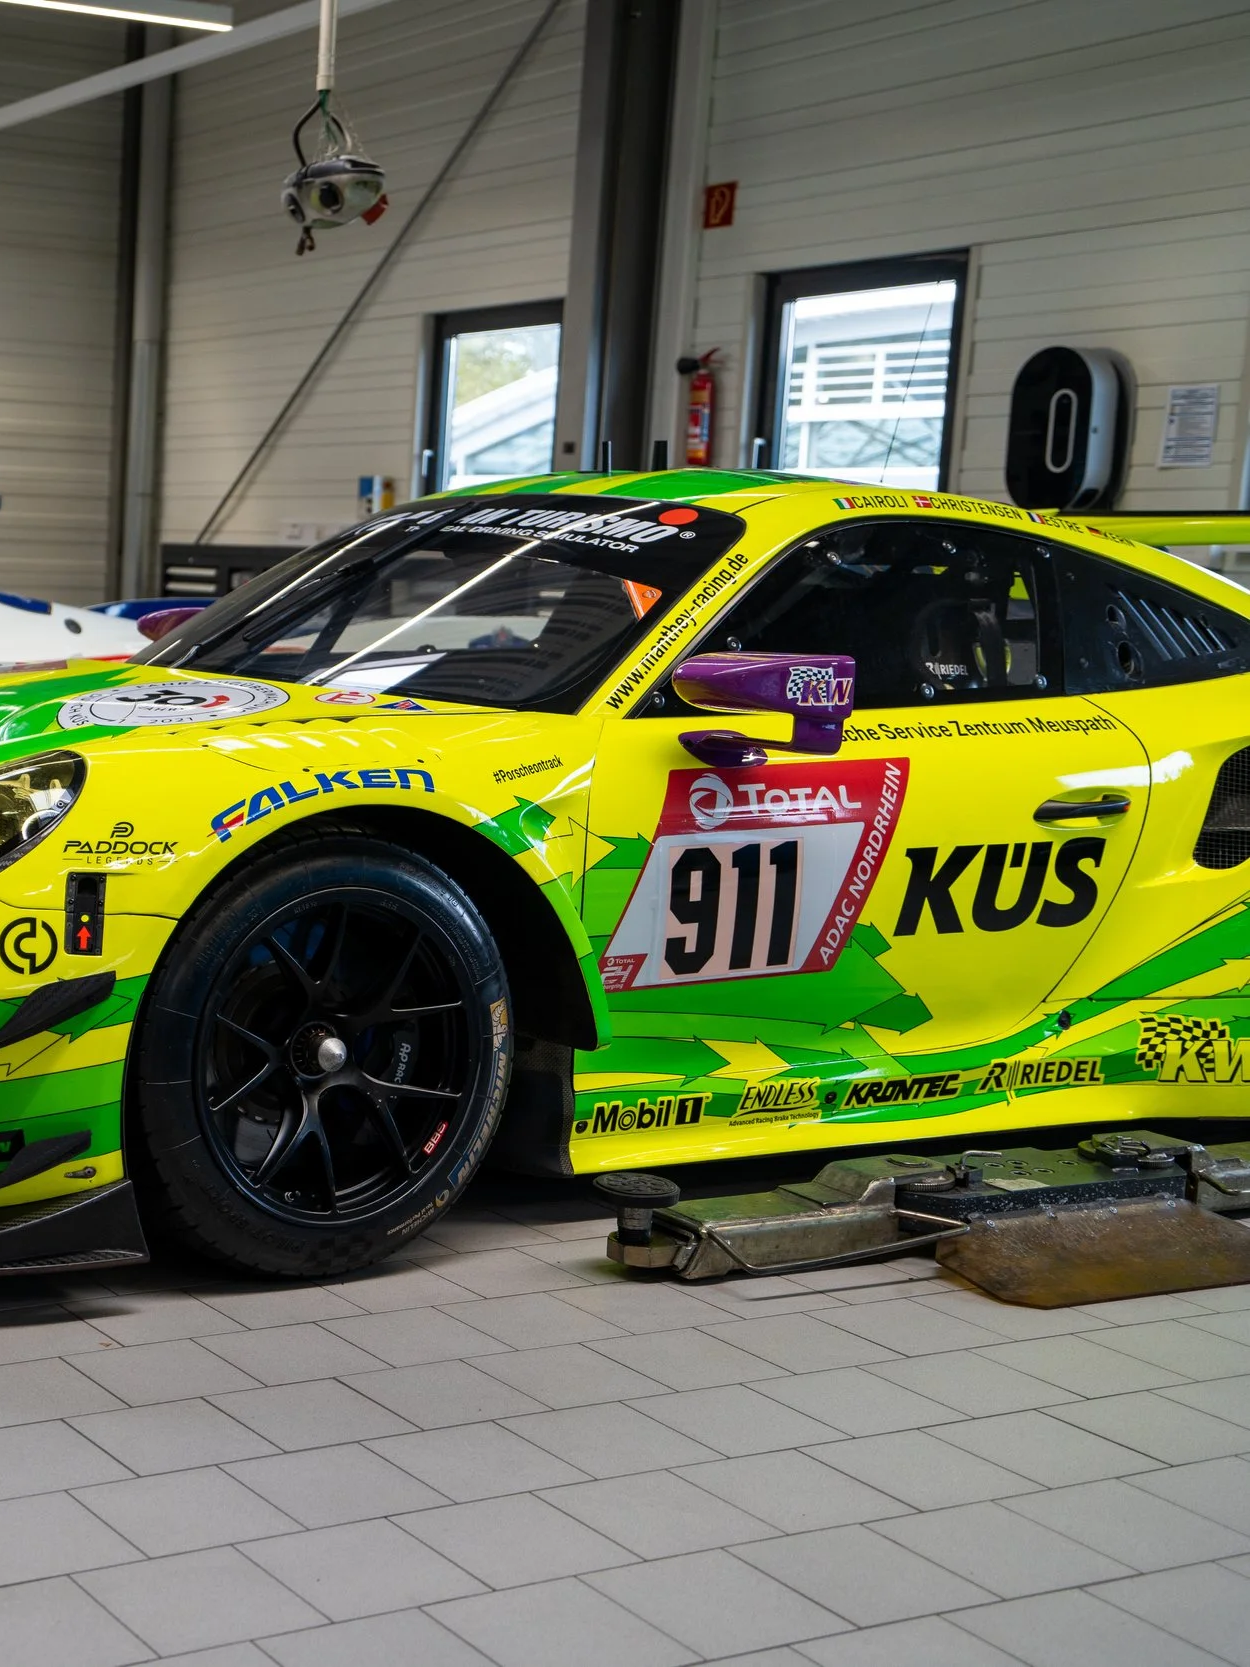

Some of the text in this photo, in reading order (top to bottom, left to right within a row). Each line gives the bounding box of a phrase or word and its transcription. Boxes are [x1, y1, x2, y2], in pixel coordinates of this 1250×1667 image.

[501, 508, 679, 544] TURISMO
[851, 495, 908, 509] CAIROLI
[929, 496, 1023, 521] CHRISTENSEN
[1043, 516, 1084, 534] ESTRE
[440, 525, 467, 533] EAL
[468, 526, 533, 537] DRIVING
[532, 529, 640, 553] SIMULATOR
[606, 553, 749, 709] www.manthey-racing.de
[797, 677, 853, 706] KW
[841, 714, 1118, 743] sche Service Zentrum Meuspath
[493, 754, 564, 784] #Porscheontrack
[208, 768, 435, 843] FALKEN
[737, 782, 862, 816] TOTAL
[62, 840, 179, 855] PADDOCK
[819, 762, 902, 965] ADAC NORDRHEIN
[893, 836, 1106, 937] KÜS
[664, 839, 799, 976] 911
[1021, 1058, 1102, 1086] RIEDEL
[739, 1081, 817, 1110] ENDLESS
[848, 1072, 961, 1107] KRONTEC
[457, 1051, 507, 1184] MICHELIN
[592, 1099, 672, 1134] Mobil
[729, 1112, 819, 1127] Advanced Racing Brake Technology
[423, 1121, 447, 1154] BBS
